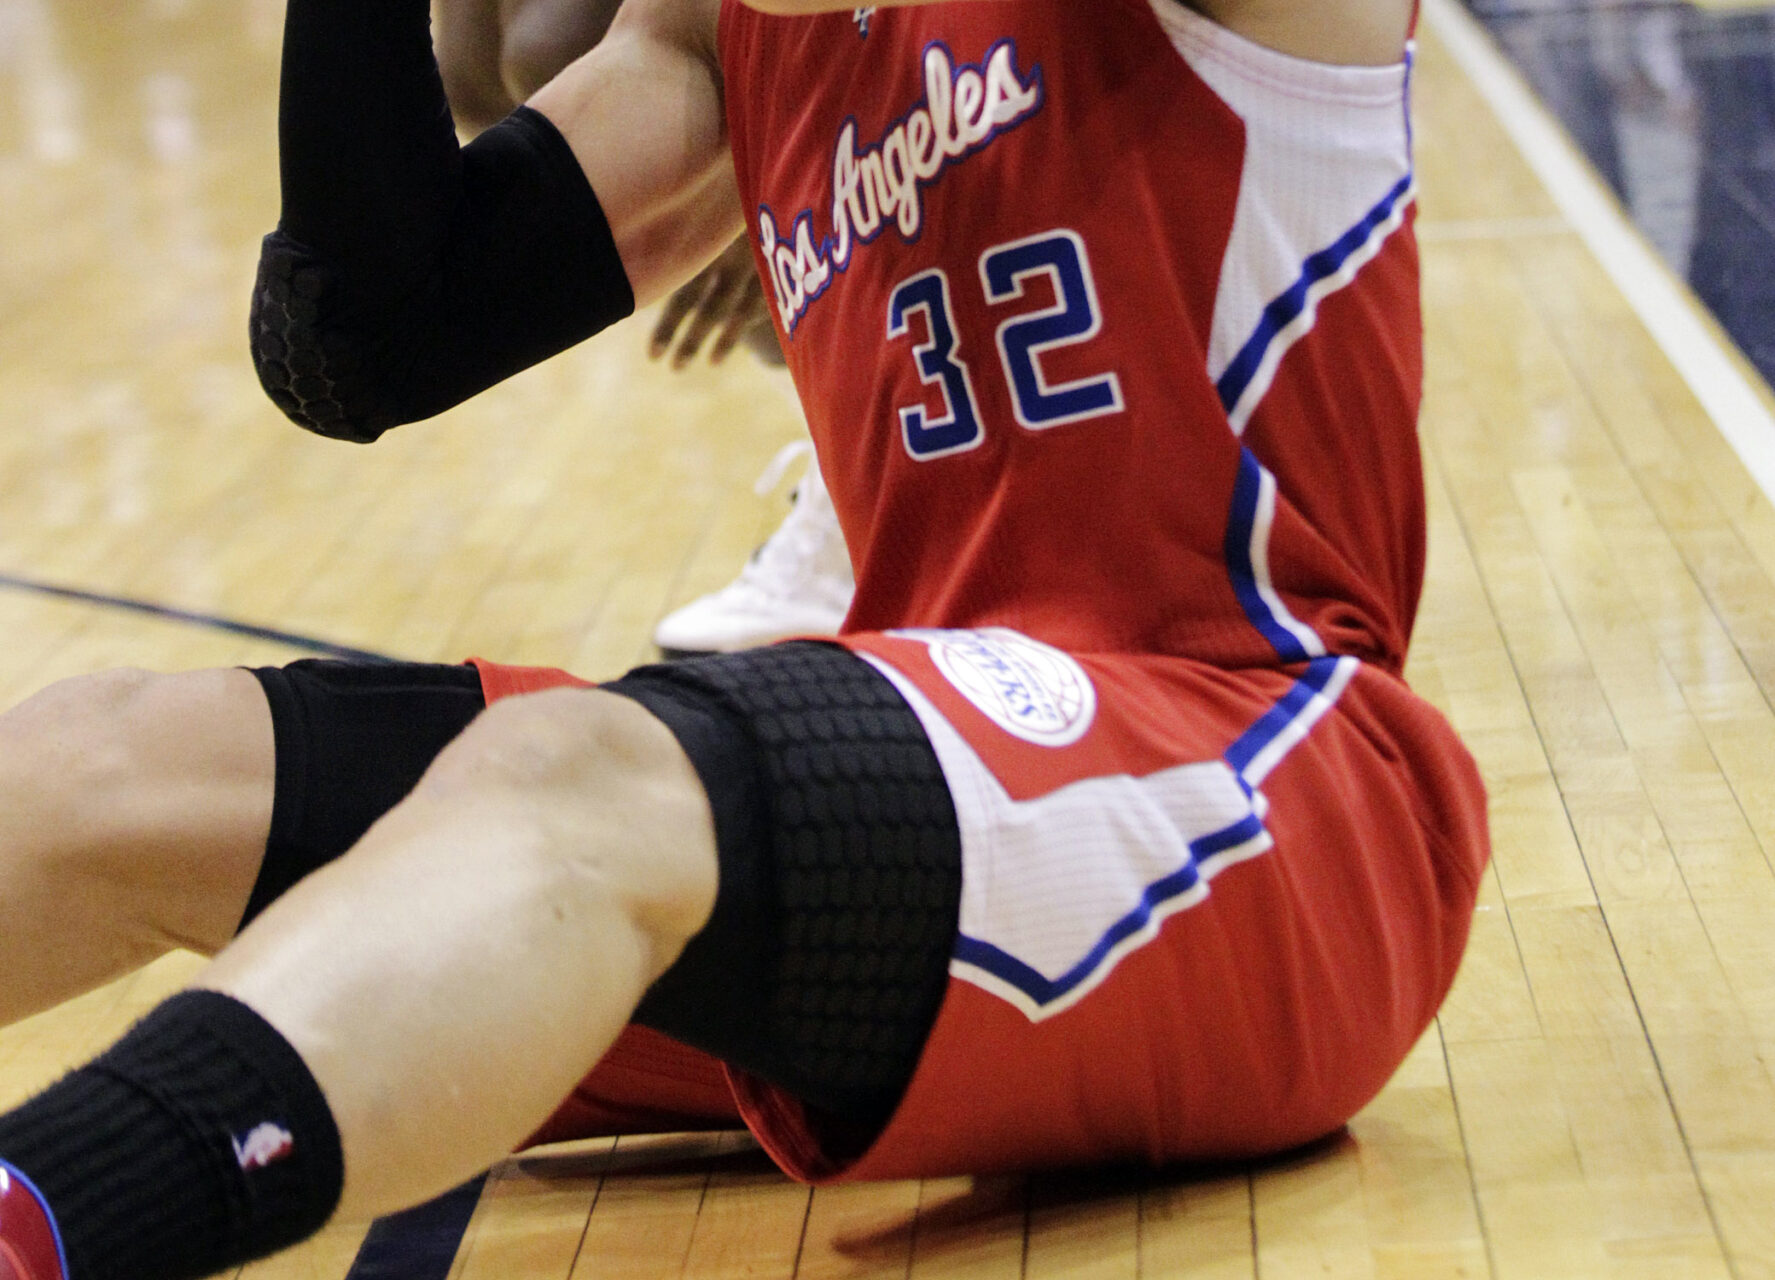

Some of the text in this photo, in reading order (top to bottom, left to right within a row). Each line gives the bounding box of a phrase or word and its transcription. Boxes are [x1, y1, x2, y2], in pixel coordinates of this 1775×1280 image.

[758, 37, 1044, 340] Los Angeles
[886, 228, 1124, 462] 32
